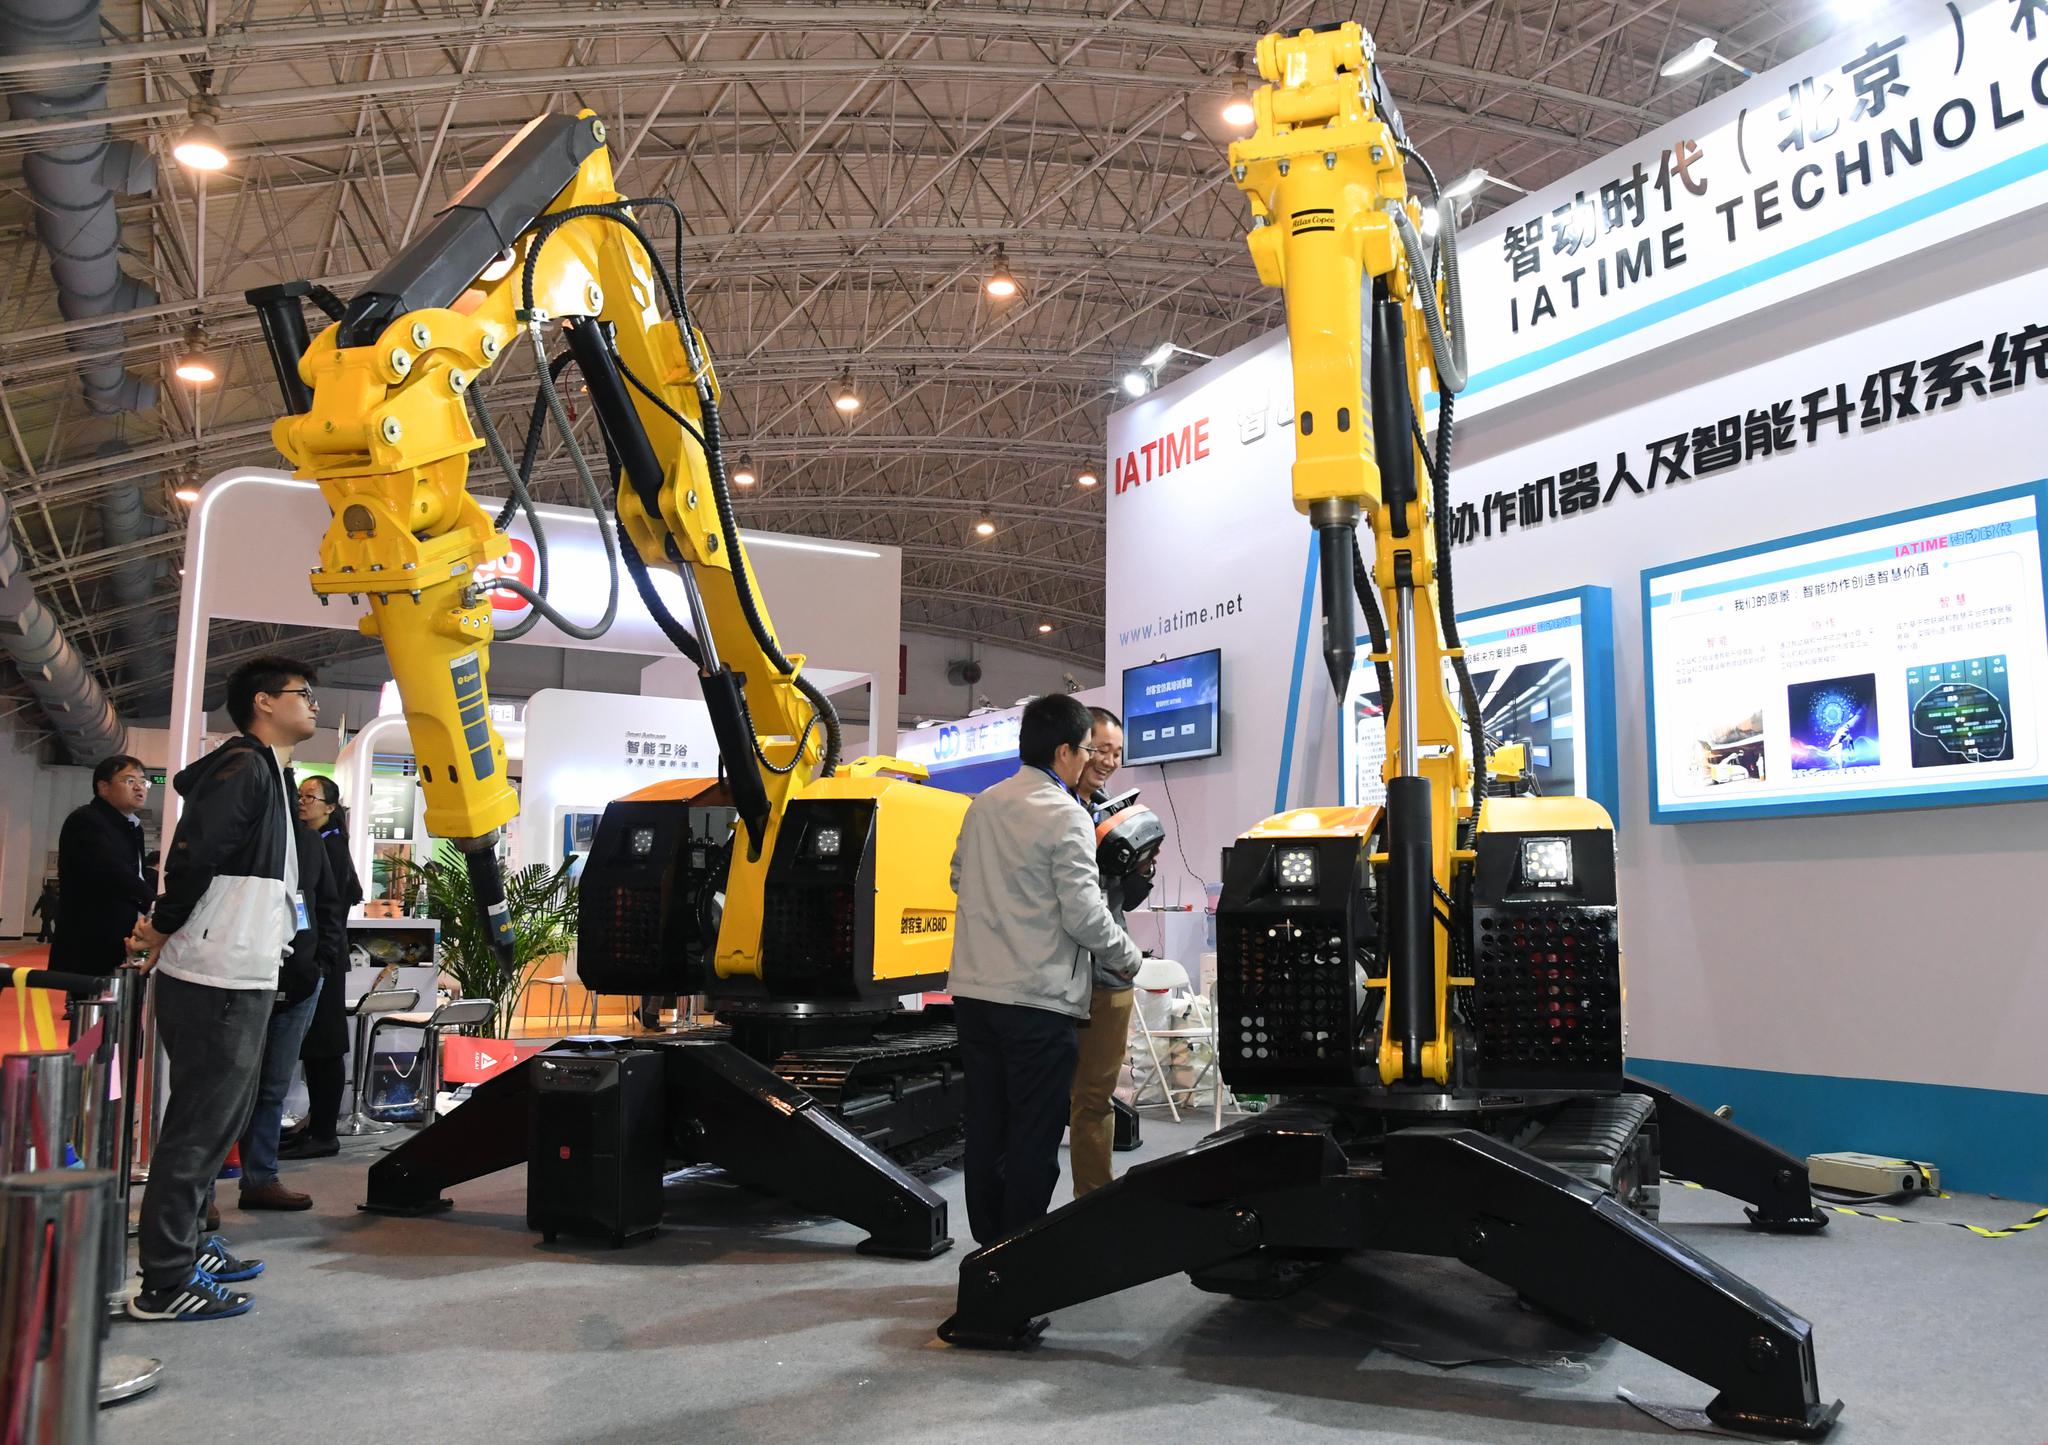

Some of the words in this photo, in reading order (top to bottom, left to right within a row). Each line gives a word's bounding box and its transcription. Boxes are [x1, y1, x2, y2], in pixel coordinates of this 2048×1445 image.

[1312, 215, 1336, 225] Copco
[1511, 222, 1687, 333] IATIME
[1449, 322, 2048, 546] 协作机器人及智能升级系统
[1114, 416, 1210, 496] IATIME
[1895, 535, 1949, 558] IATIME
[1119, 592, 1244, 647] www.iatime.net
[1506, 624, 1537, 639] IATIME
[626, 740, 688, 758] 智能卫浴
